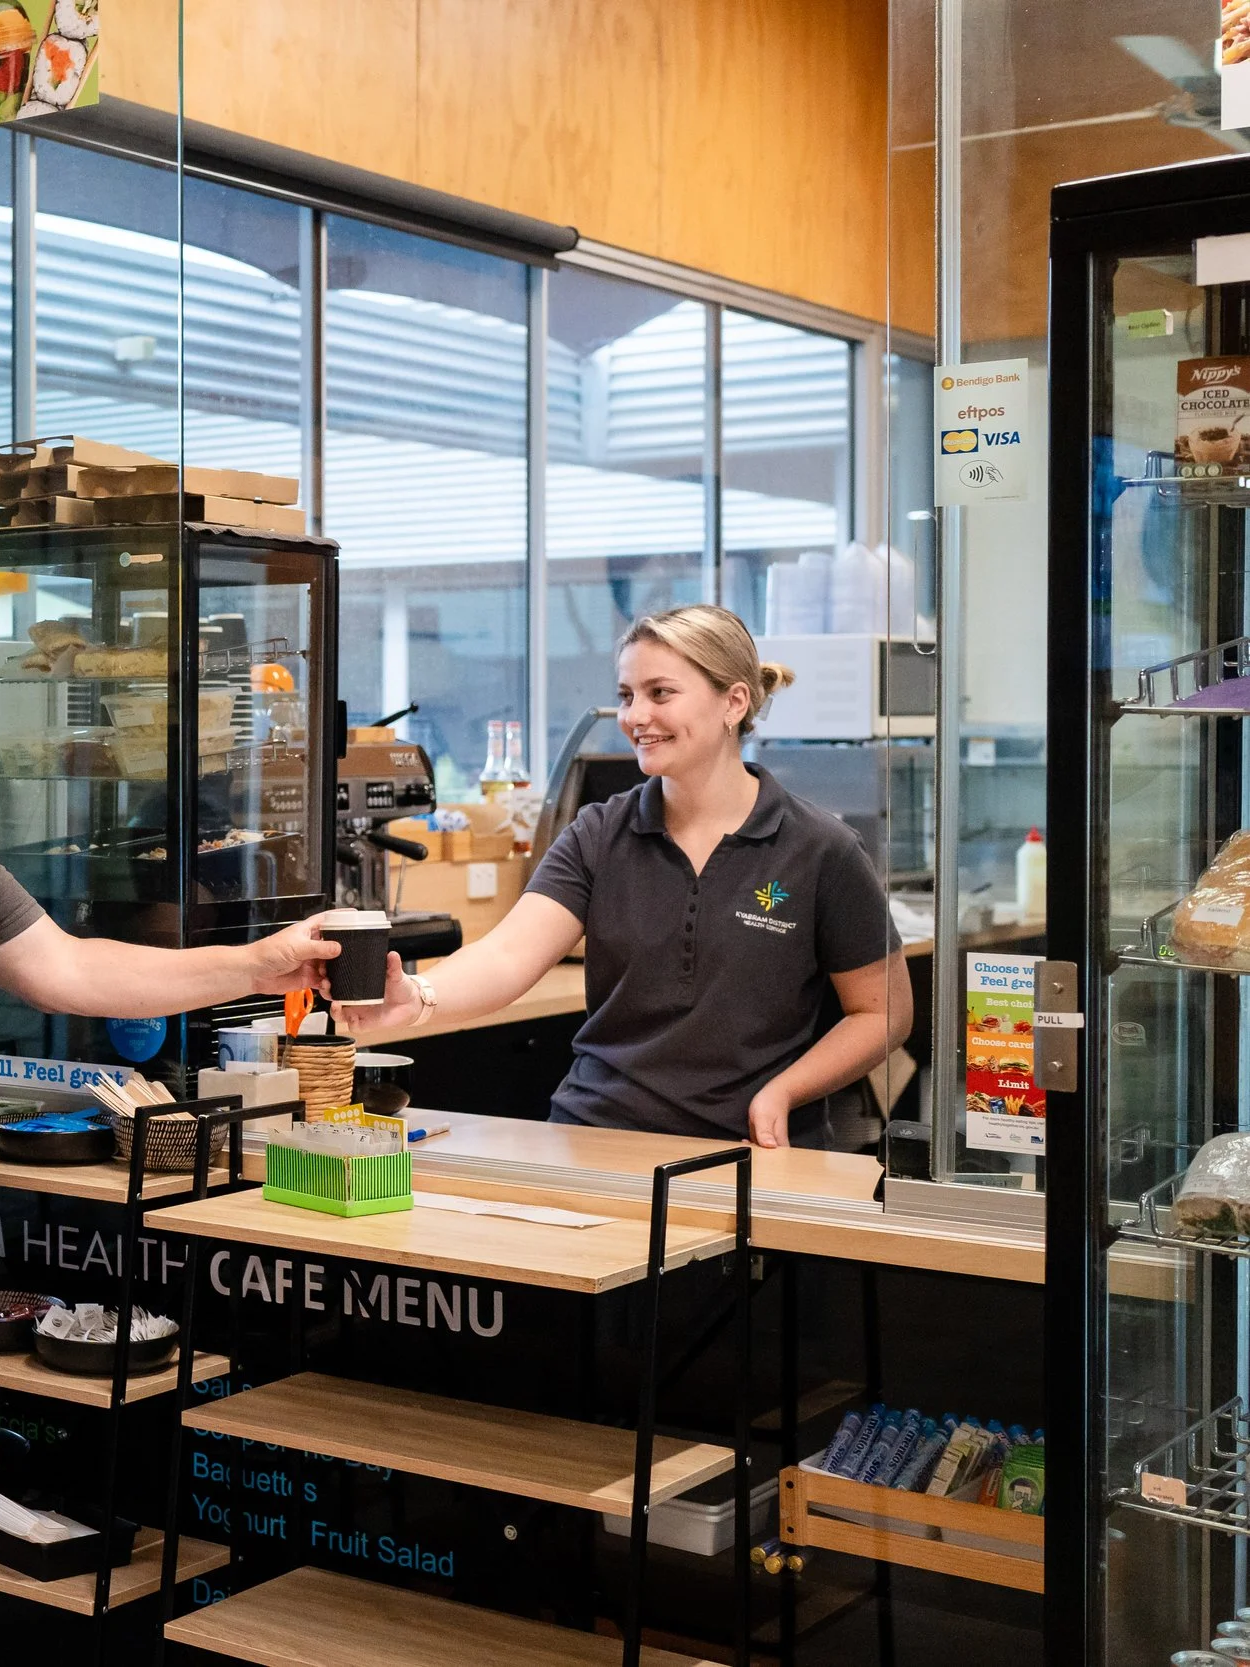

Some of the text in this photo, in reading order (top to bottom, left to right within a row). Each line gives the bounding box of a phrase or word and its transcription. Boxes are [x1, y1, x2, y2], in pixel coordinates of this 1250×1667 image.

[956, 373, 1020, 388] Bendigo Bank
[1190, 364, 1241, 386] Nippy's
[1203, 389, 1230, 399] ICED
[1181, 399, 1250, 411] CHOCOLATE
[957, 405, 1005, 422] eftpos
[982, 431, 1021, 446] VISA
[735, 911, 797, 929] KYABRAM DISTRICT
[743, 919, 765, 928] HEALTH
[974, 962, 1019, 974] Choose
[980, 976, 1034, 990] Feel gre
[986, 998, 1034, 1009] Best choi
[1037, 1016, 1063, 1025] PULL
[972, 1037, 1006, 1047] Choose
[23, 1061, 65, 1083] Feel
[70, 1067, 124, 1089] gret
[997, 1079, 1030, 1090] Limit
[23, 1219, 189, 1285] HEALTH
[210, 1250, 325, 1311] CAFE
[343, 1270, 503, 1338] MENU
[827, 1444, 846, 1473] entos
[311, 1520, 369, 1559] Fruit
[377, 1535, 454, 1577] Salad
